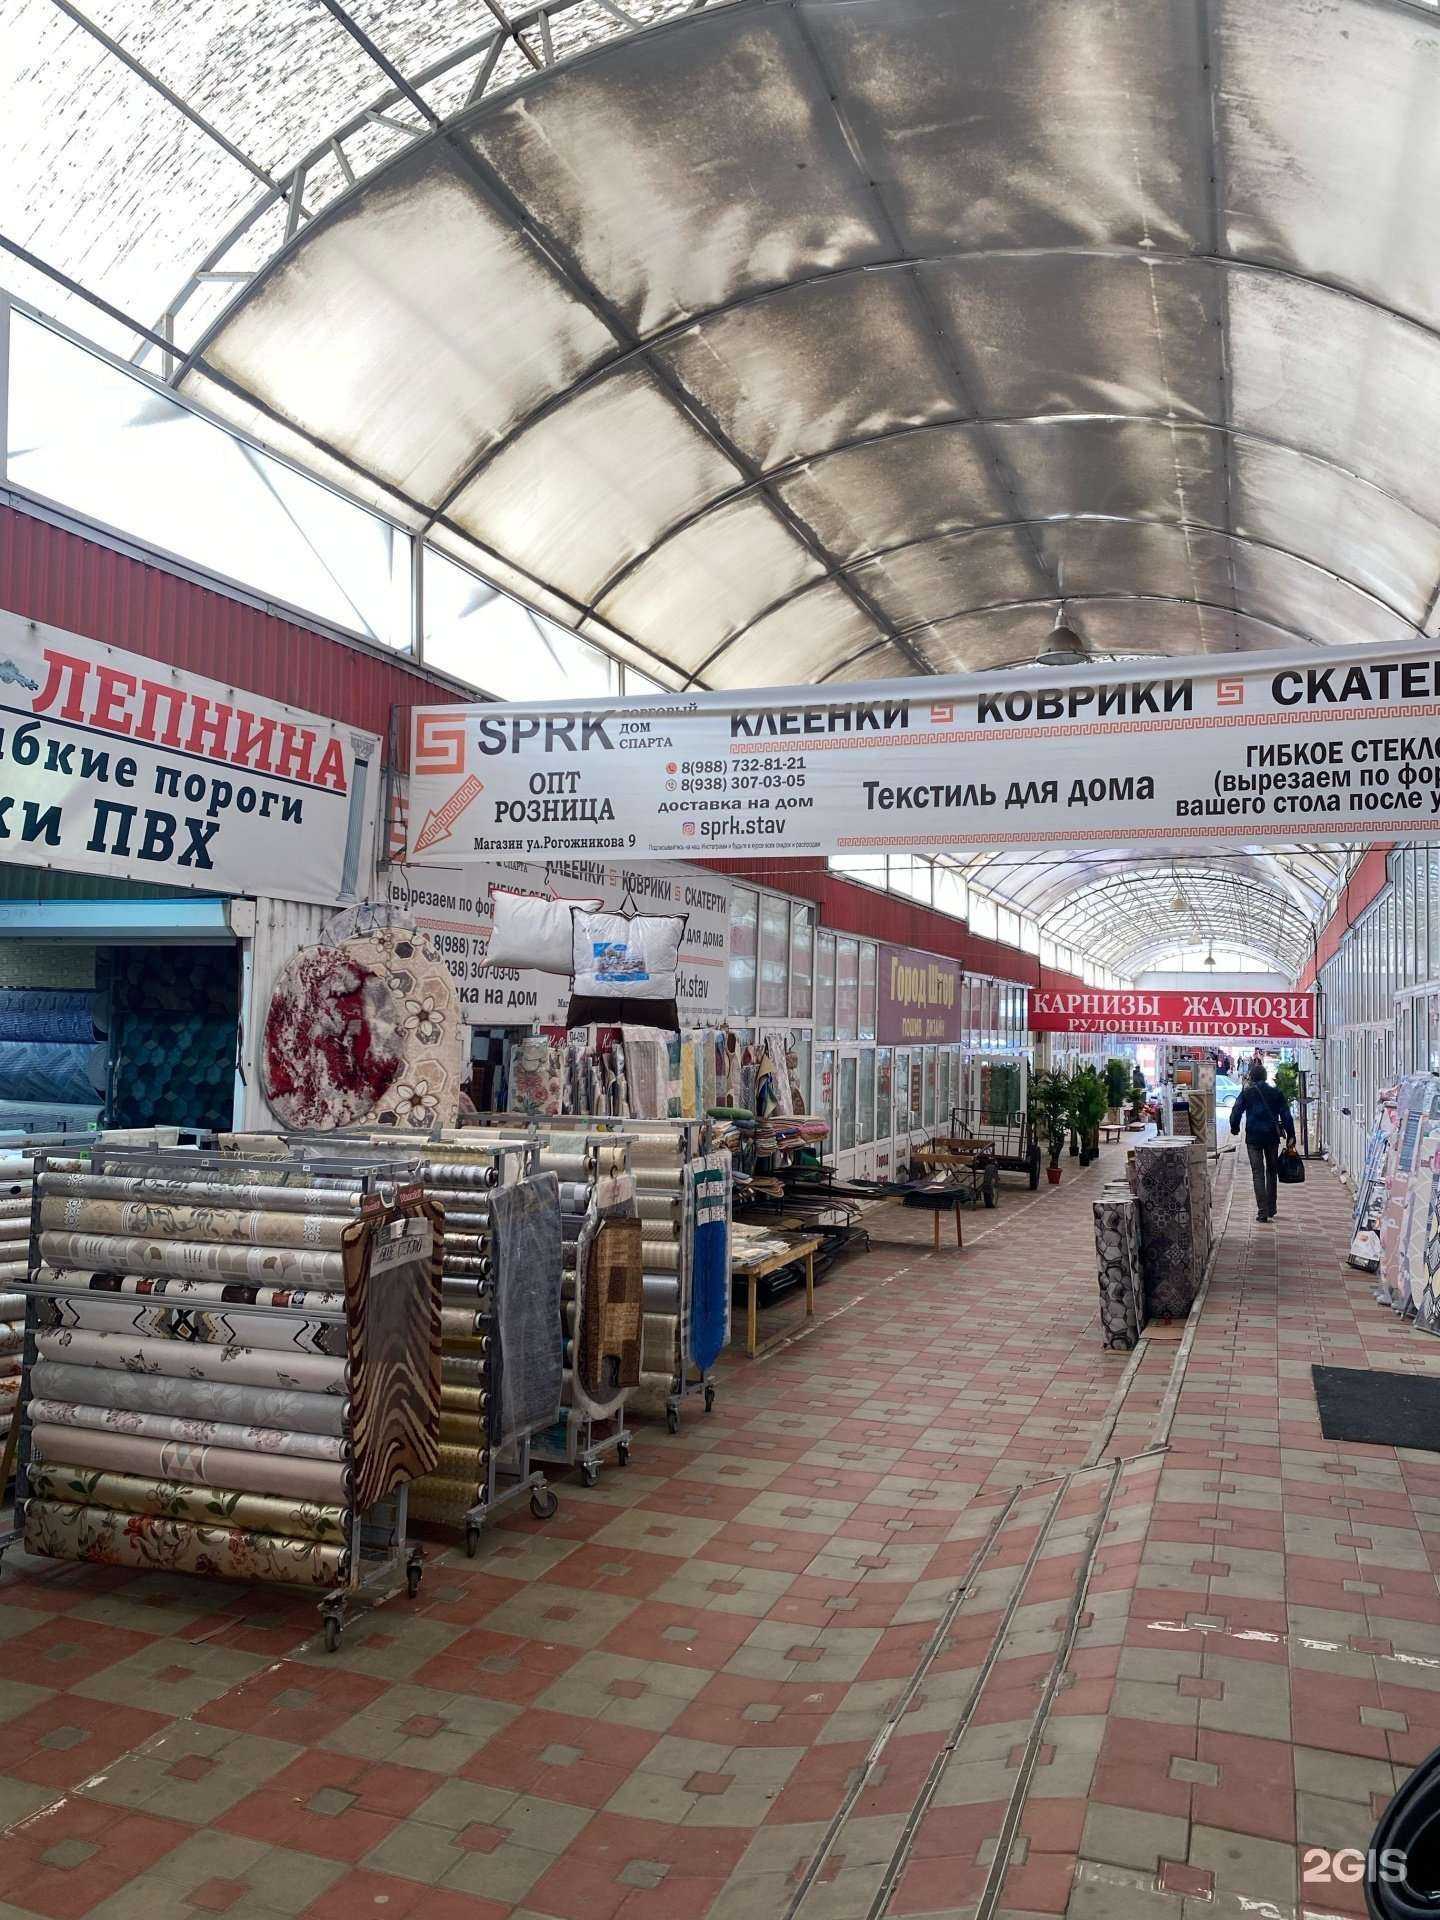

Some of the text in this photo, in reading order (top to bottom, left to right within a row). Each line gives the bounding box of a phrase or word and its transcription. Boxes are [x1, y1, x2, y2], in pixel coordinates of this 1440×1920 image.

[977, 678, 1193, 724] КОВРИКИ
[1271, 661, 1440, 705] СКАТЕ
[32, 648, 347, 791] ЛЕПНИНА
[619, 722, 650, 735] ДОМ
[478, 710, 616, 755] SPRK
[619, 737, 673, 749] СПАРТА
[681, 757, 806, 776] 8(988) 732-81-21
[1246, 741, 1343, 768] ГИБКОЕ
[0, 721, 303, 825] бкие пороги
[529, 770, 581, 794] ОПТ
[681, 775, 806, 793] 8(938) 307-03-05
[1214, 770, 1351, 797] (вырезаем
[1360, 768, 1389, 786] по
[658, 796, 813, 813] доставка на дом
[863, 775, 1154, 810] Текстиль для дома
[1176, 797, 1266, 816] вашего
[1273, 793, 1341, 814] стола
[1350, 790, 1423, 811] после
[495, 798, 615, 824] РОЗНИЦА
[86, 799, 220, 870] ПВХ
[700, 815, 786, 840] sprk.stav
[474, 837, 523, 850] Магазин
[628, 834, 636, 847] 9
[459, 900, 472, 912] по
[685, 886, 727, 914] СКАТЕРТИ
[434, 934, 469, 958] 8(988)
[703, 931, 724, 948] дома
[485, 988, 503, 1004] на
[507, 991, 537, 1008] дом
[1032, 994, 1310, 1019] КАРНИЗЫ ЖАЛЮЗИ
[1068, 1018, 1269, 1037] РУЛОННЫЕ ШТОРЫ
